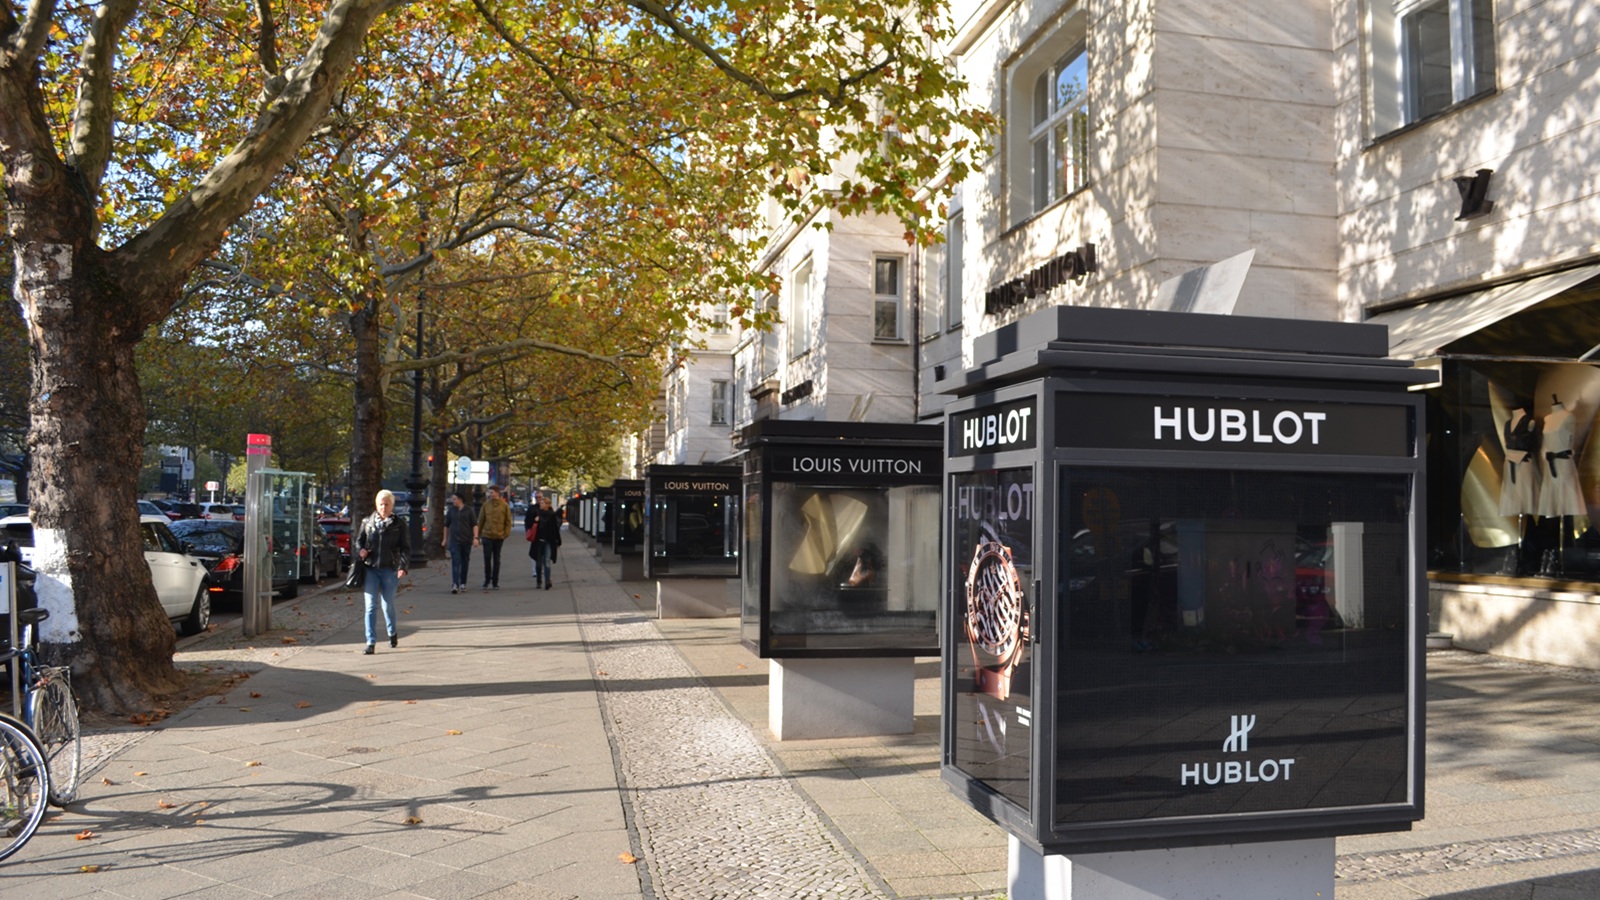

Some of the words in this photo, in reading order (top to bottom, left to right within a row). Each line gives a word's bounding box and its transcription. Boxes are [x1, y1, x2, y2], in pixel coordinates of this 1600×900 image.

[963, 407, 1031, 449] HUBLOT
[1154, 406, 1326, 444] HUBLOT
[793, 457, 842, 473] LOUIS
[848, 459, 922, 474] VUITTON
[664, 481, 690, 490] LOUIS
[692, 482, 729, 491] VUITTON
[959, 483, 1033, 521] HUBLOT
[1181, 758, 1295, 786] HUBLOT
